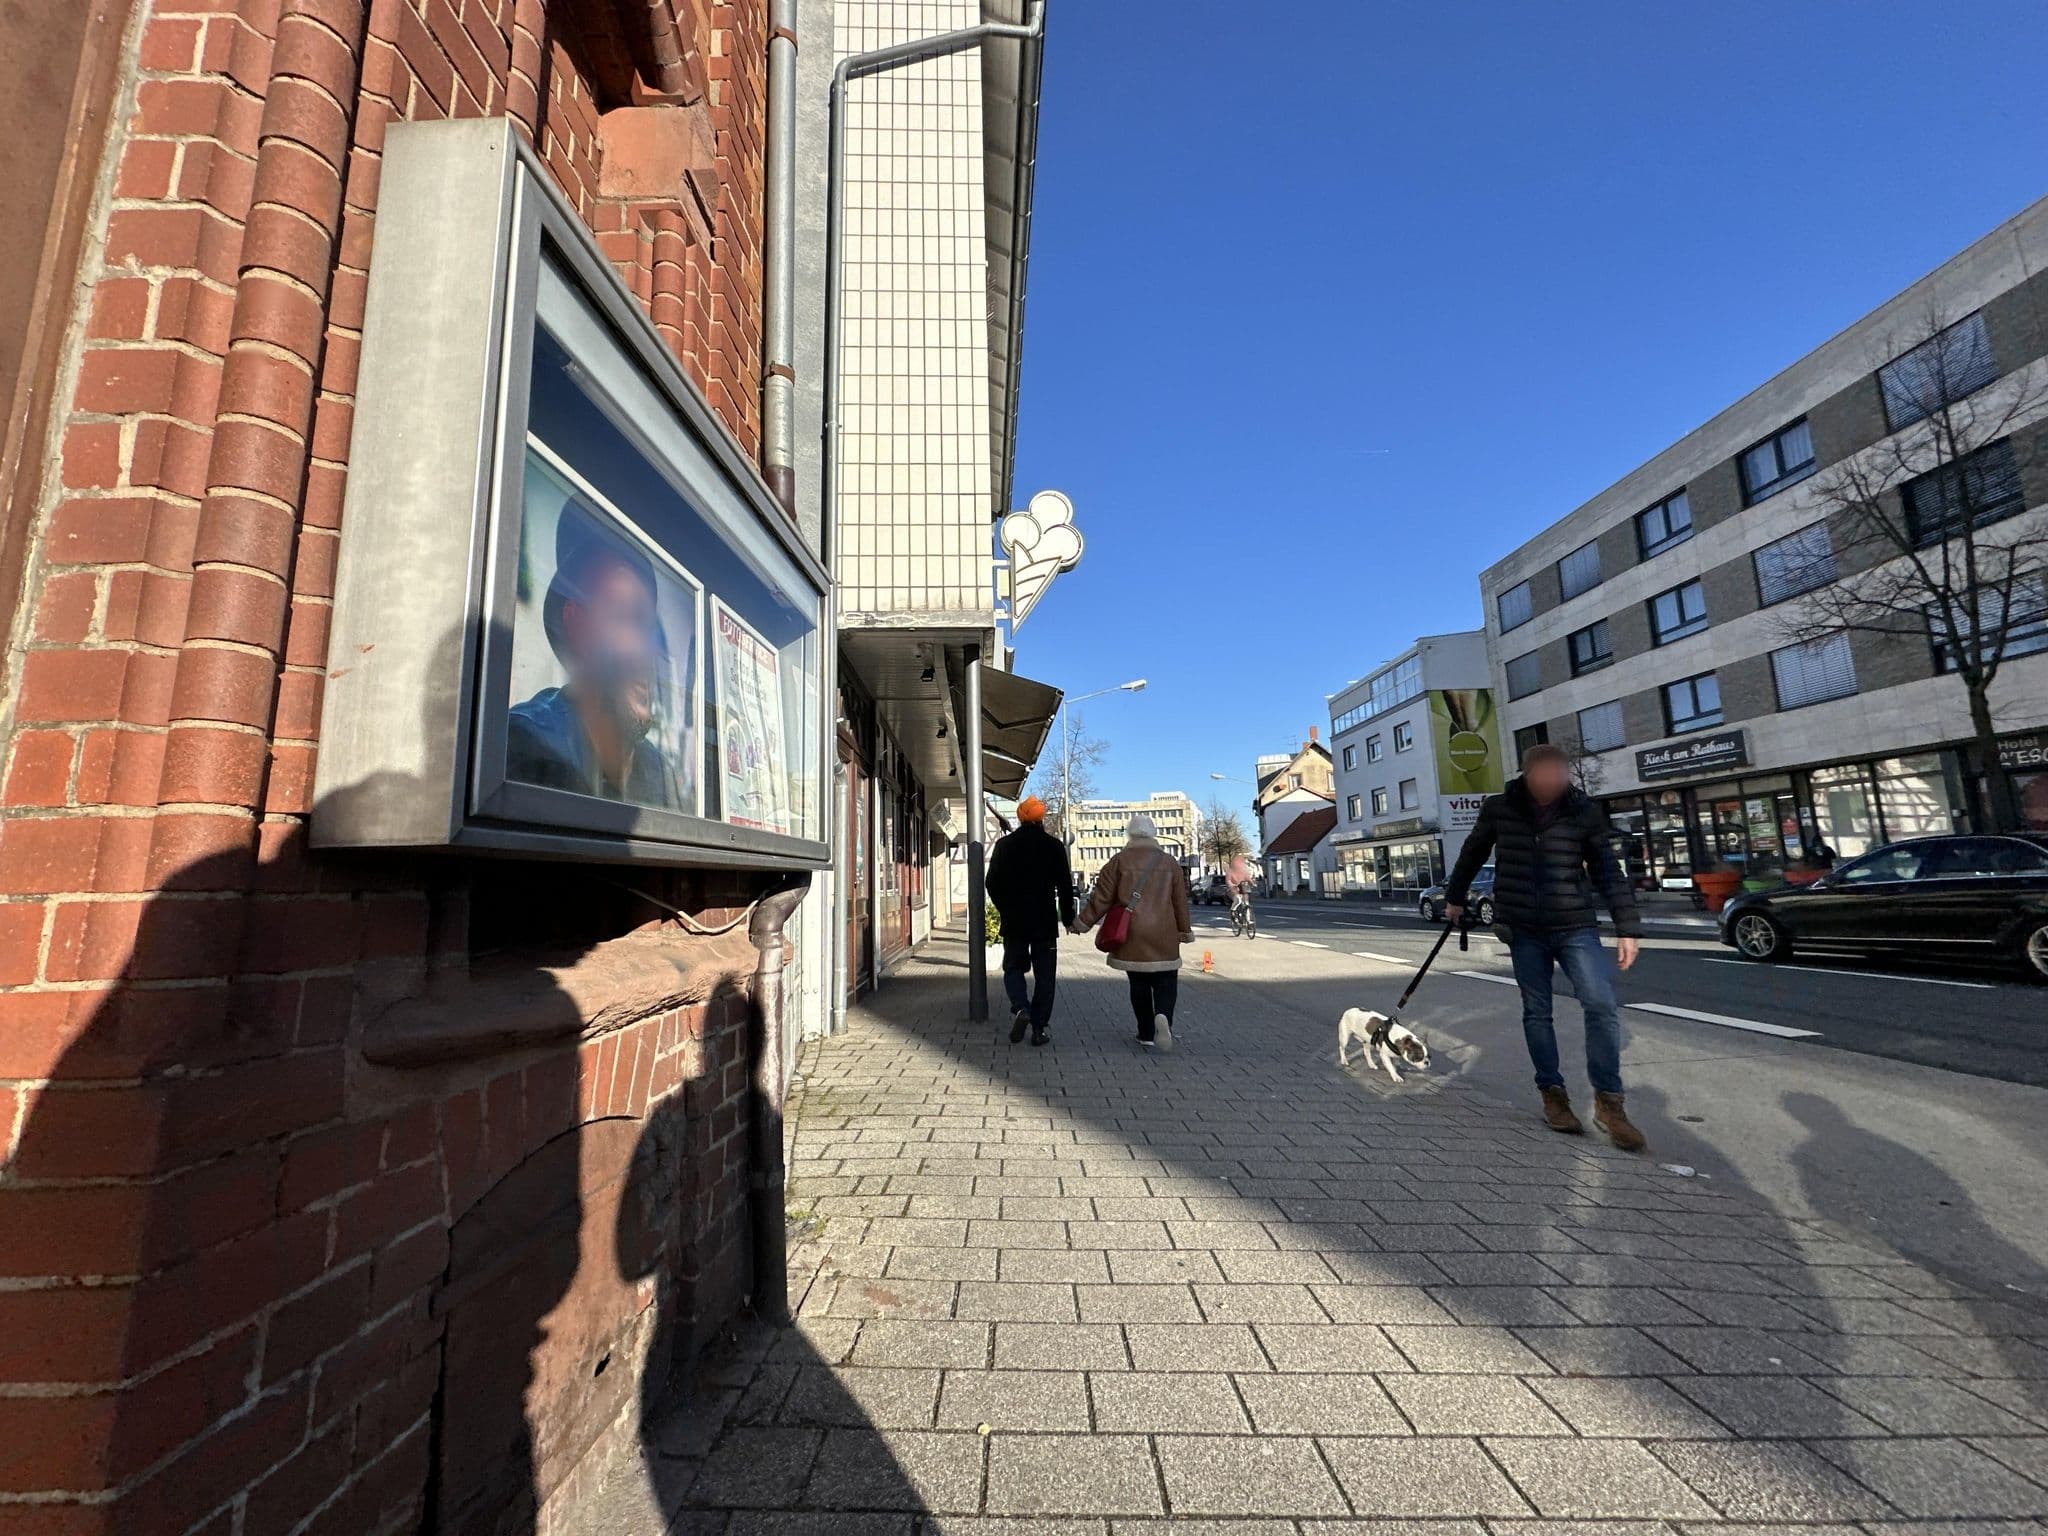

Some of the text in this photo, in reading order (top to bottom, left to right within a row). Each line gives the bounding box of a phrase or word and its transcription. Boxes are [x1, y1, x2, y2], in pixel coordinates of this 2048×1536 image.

[1643, 740, 1736, 766] Kiosk am Rathaus
[1997, 736, 2039, 750] Hotel
